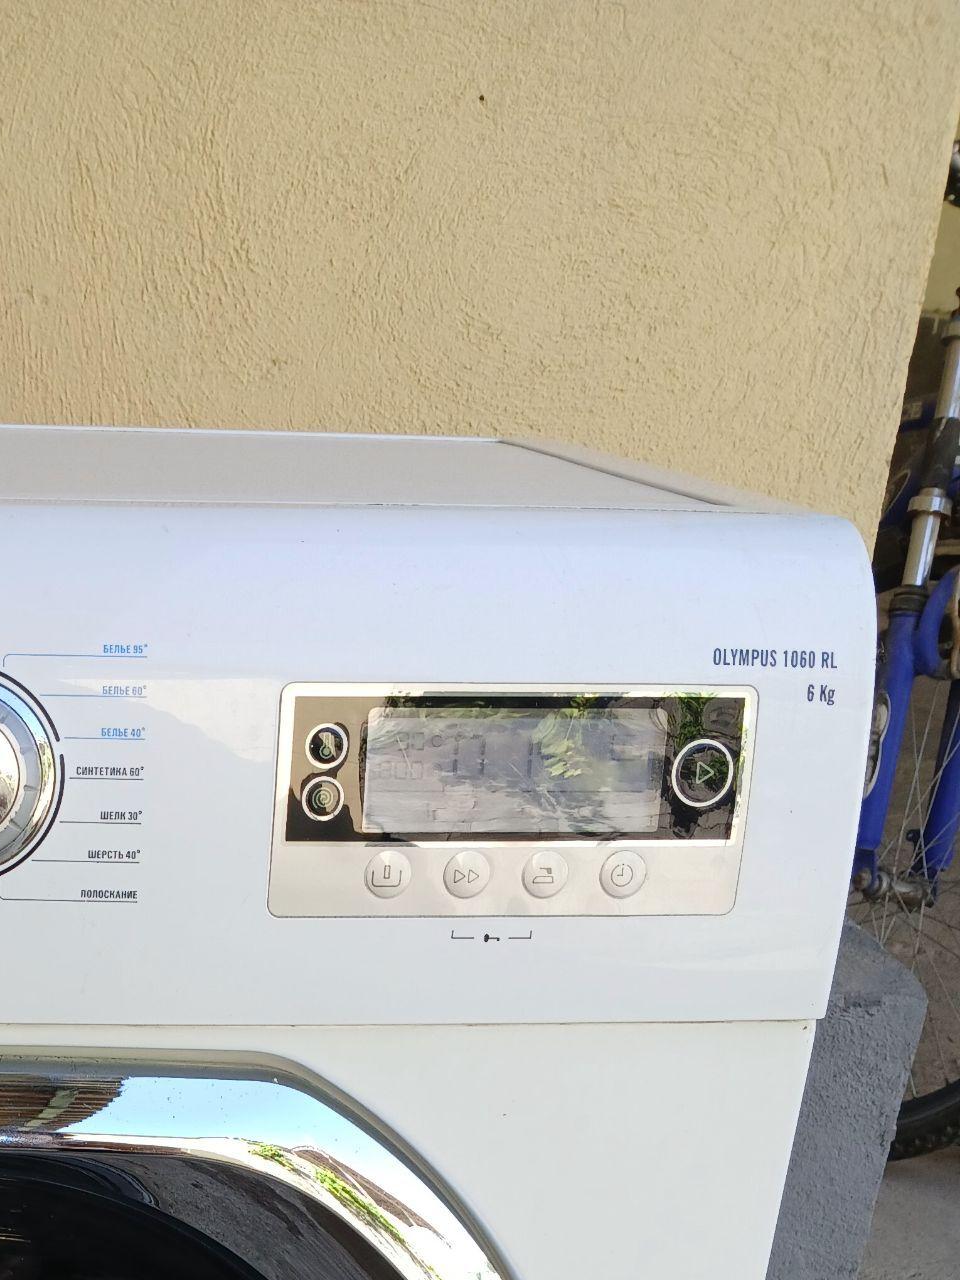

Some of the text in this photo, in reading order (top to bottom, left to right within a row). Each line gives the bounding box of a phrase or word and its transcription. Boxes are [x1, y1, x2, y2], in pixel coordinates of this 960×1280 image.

[103, 644, 131, 654] БЕЛЬЕ
[713, 648, 838, 669] OLYMPUS 1060 RL
[102, 685, 130, 696] БЕЛЬЕ
[806, 684, 836, 705] 6 Kg
[101, 727, 129, 737] БЕЛЬЕ
[76, 766, 128, 777] СИНТЕТИКА
[100, 811, 126, 821] ШЕЛК
[88, 850, 124, 860] ШЕРСТЬ
[80, 889, 138, 900] ПОЛОСКАНИЕ
